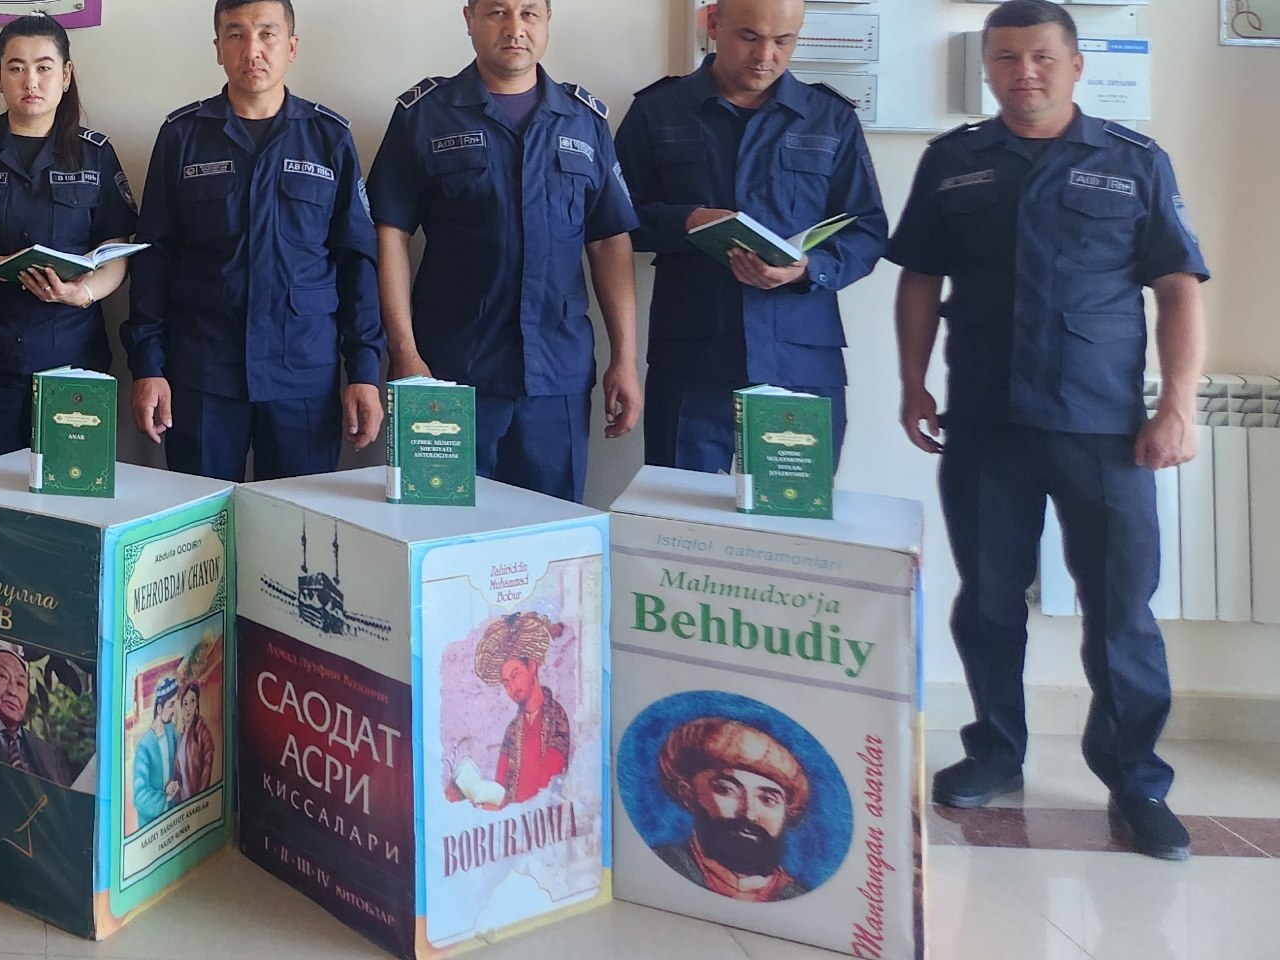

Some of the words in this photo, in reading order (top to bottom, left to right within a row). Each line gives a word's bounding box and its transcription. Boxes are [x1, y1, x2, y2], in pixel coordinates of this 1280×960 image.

[134, 570, 186, 614] MEHROBDAN
[188, 556, 220, 590] CHAYON
[496, 590, 522, 603] Bobur
[724, 544, 842, 570] qahramonlari
[630, 591, 876, 678] Behbudiy
[257, 670, 401, 769] САОДАТ
[280, 734, 370, 816] АСРИ
[856, 734, 883, 817] asarlar
[263, 773, 400, 865] ҚИССАЛАРИ
[443, 802, 577, 878] BOBURNOMA
